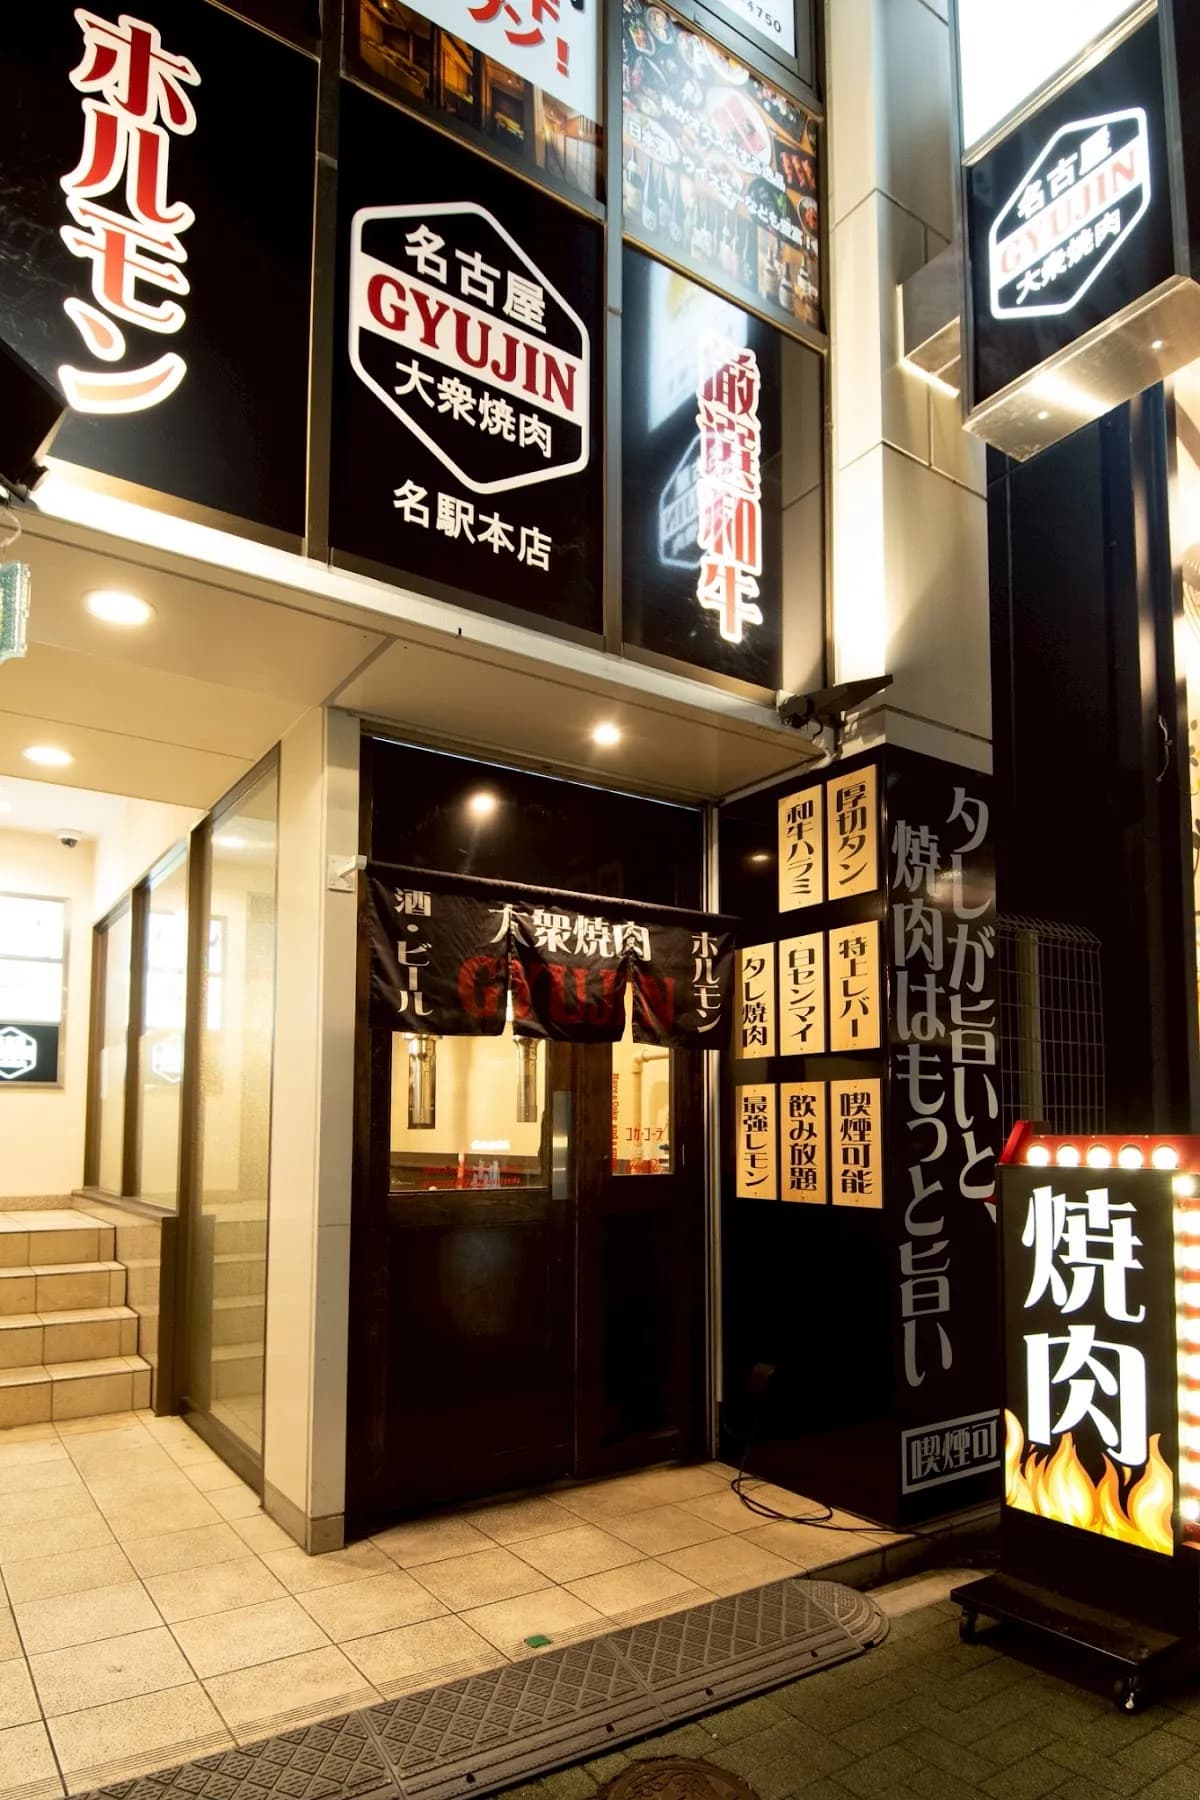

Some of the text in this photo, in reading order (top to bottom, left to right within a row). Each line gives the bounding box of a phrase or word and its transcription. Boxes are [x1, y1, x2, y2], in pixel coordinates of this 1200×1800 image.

[59, 8, 201, 414] ホルモン
[1001, 149, 1136, 274] GYUJIN
[1017, 124, 1112, 220] 名古屋
[404, 223, 548, 334] 名古屋
[1016, 208, 1121, 305] 大衆焼肉
[366, 273, 577, 412] GYUJIN
[394, 358, 553, 459] 大衆焼肉
[392, 478, 553, 572] 名駅本店
[786, 799, 815, 895] 和牛ハラミ
[836, 780, 868, 886] 厚切タン
[488, 903, 652, 962] 大衆焼肉
[691, 931, 722, 1033] ホルモン
[741, 957, 768, 1049] タレ焼肉
[787, 947, 817, 1043] 白センマイ
[839, 936, 870, 1038] 特上レバー
[743, 1095, 769, 1188] 最強レモン
[789, 1094, 818, 1192] 飲み放題
[840, 1092, 873, 1194] 喫煙可能
[891, 819, 953, 1387] 焼肉はもっと旨い
[1021, 1185, 1148, 1467] 焼肉
